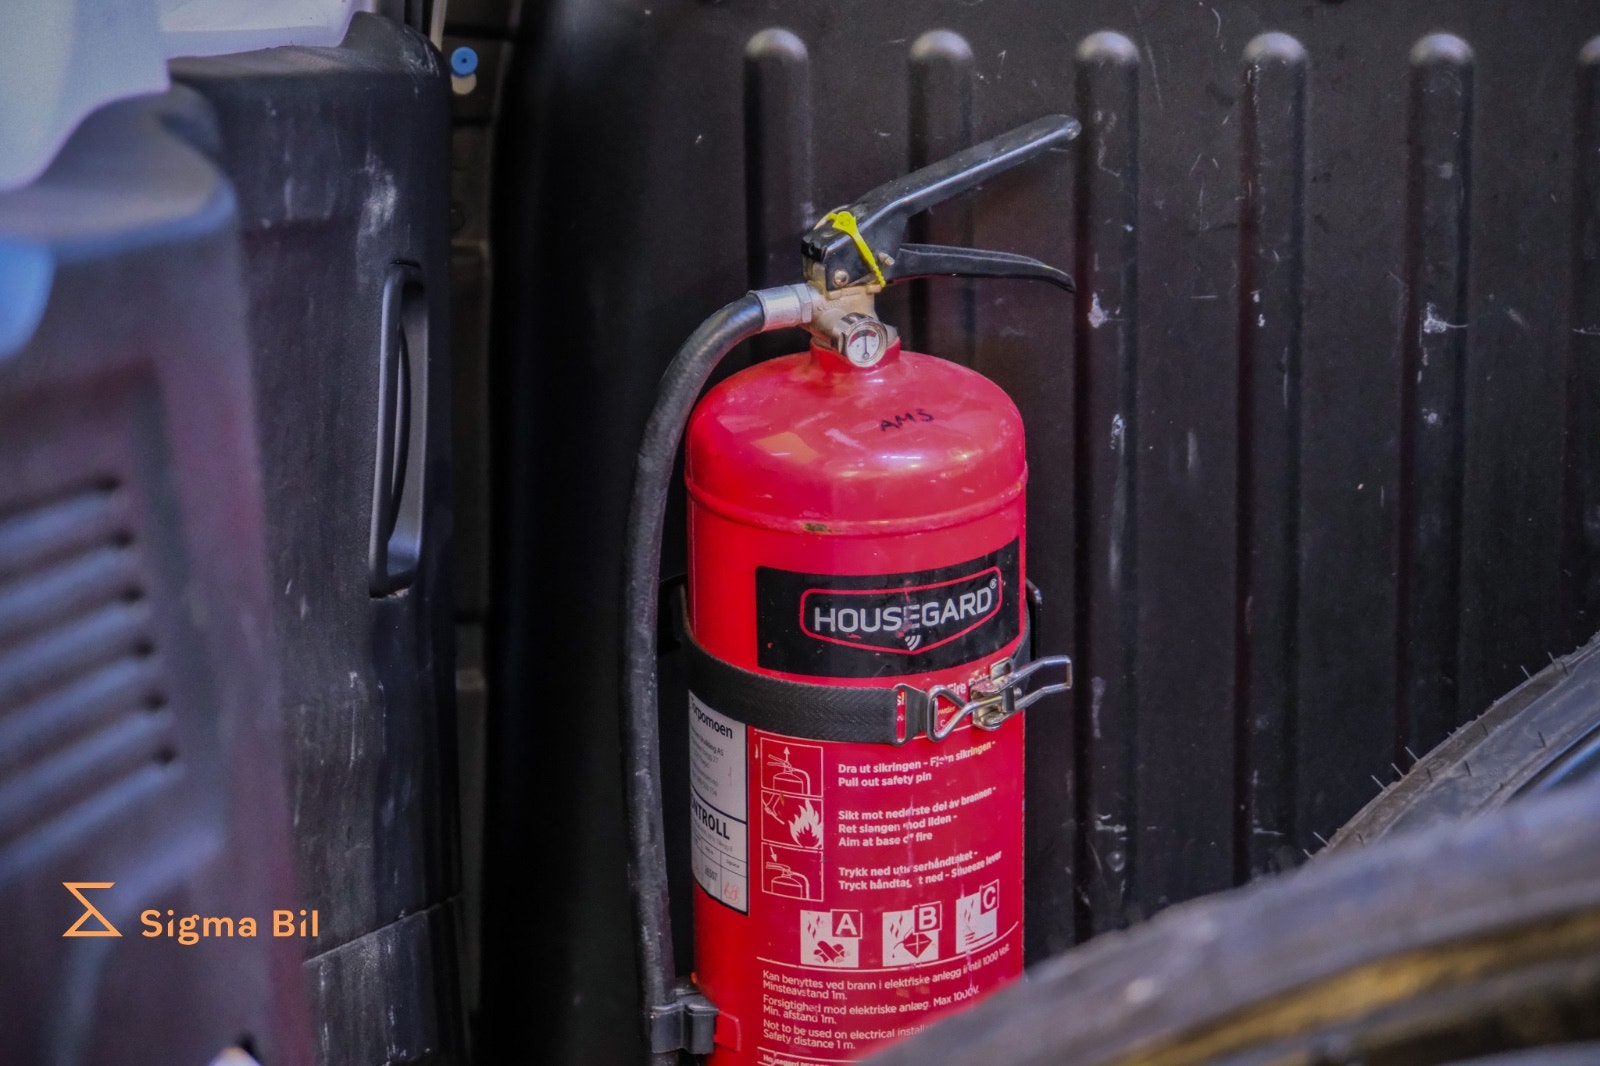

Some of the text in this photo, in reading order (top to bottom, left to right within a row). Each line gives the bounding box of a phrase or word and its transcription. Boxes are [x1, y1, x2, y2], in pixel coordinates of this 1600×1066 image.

[880, 409, 934, 432] AMS
[838, 764, 857, 774] Dra
[860, 763, 871, 773] ut
[873, 760, 921, 773] sikringen
[956, 742, 991, 761] sikringen
[838, 771, 932, 787] Pull out safety pin
[838, 810, 859, 820] Sikt
[861, 809, 883, 820] mot
[932, 800, 947, 813] del
[949, 799, 959, 810] av
[961, 787, 993, 806] brannen
[838, 824, 857, 833] Ret
[859, 822, 900, 834] slangen
[928, 814, 951, 827] ilden
[838, 837, 860, 847] Aim
[862, 836, 873, 846] at
[876, 835, 900, 846] base
[915, 831, 932, 842] fire
[838, 866, 868, 878] Trykk
[870, 866, 891, 876] ned
[838, 880, 868, 891] Tryck
[925, 871, 943, 884] ned
[982, 886, 996, 909] C
[836, 913, 857, 935] A
[919, 907, 937, 930] B
[763, 969, 780, 982] Kan
[782, 974, 823, 989] benyttes
[826, 980, 844, 990] ved
[847, 980, 876, 990] brann
[879, 980, 882, 989] i
[884, 974, 930, 989] elektriske
[932, 968, 962, 983] anlegg
[763, 980, 847, 1000] Minsteavstand 1m.
[763, 1004, 837, 1025] Min. afstand 1m.
[824, 1006, 846, 1015] mod
[849, 1003, 897, 1015] elektriske
[933, 996, 951, 1007] Max
[763, 1019, 780, 1031] Not
[782, 1023, 792, 1033] to
[794, 1025, 806, 1036] be
[808, 1029, 832, 1038] used
[834, 1031, 847, 1039] on
[850, 1029, 895, 1039] electrical
[763, 1029, 856, 1050] Safety distance 1 m.
